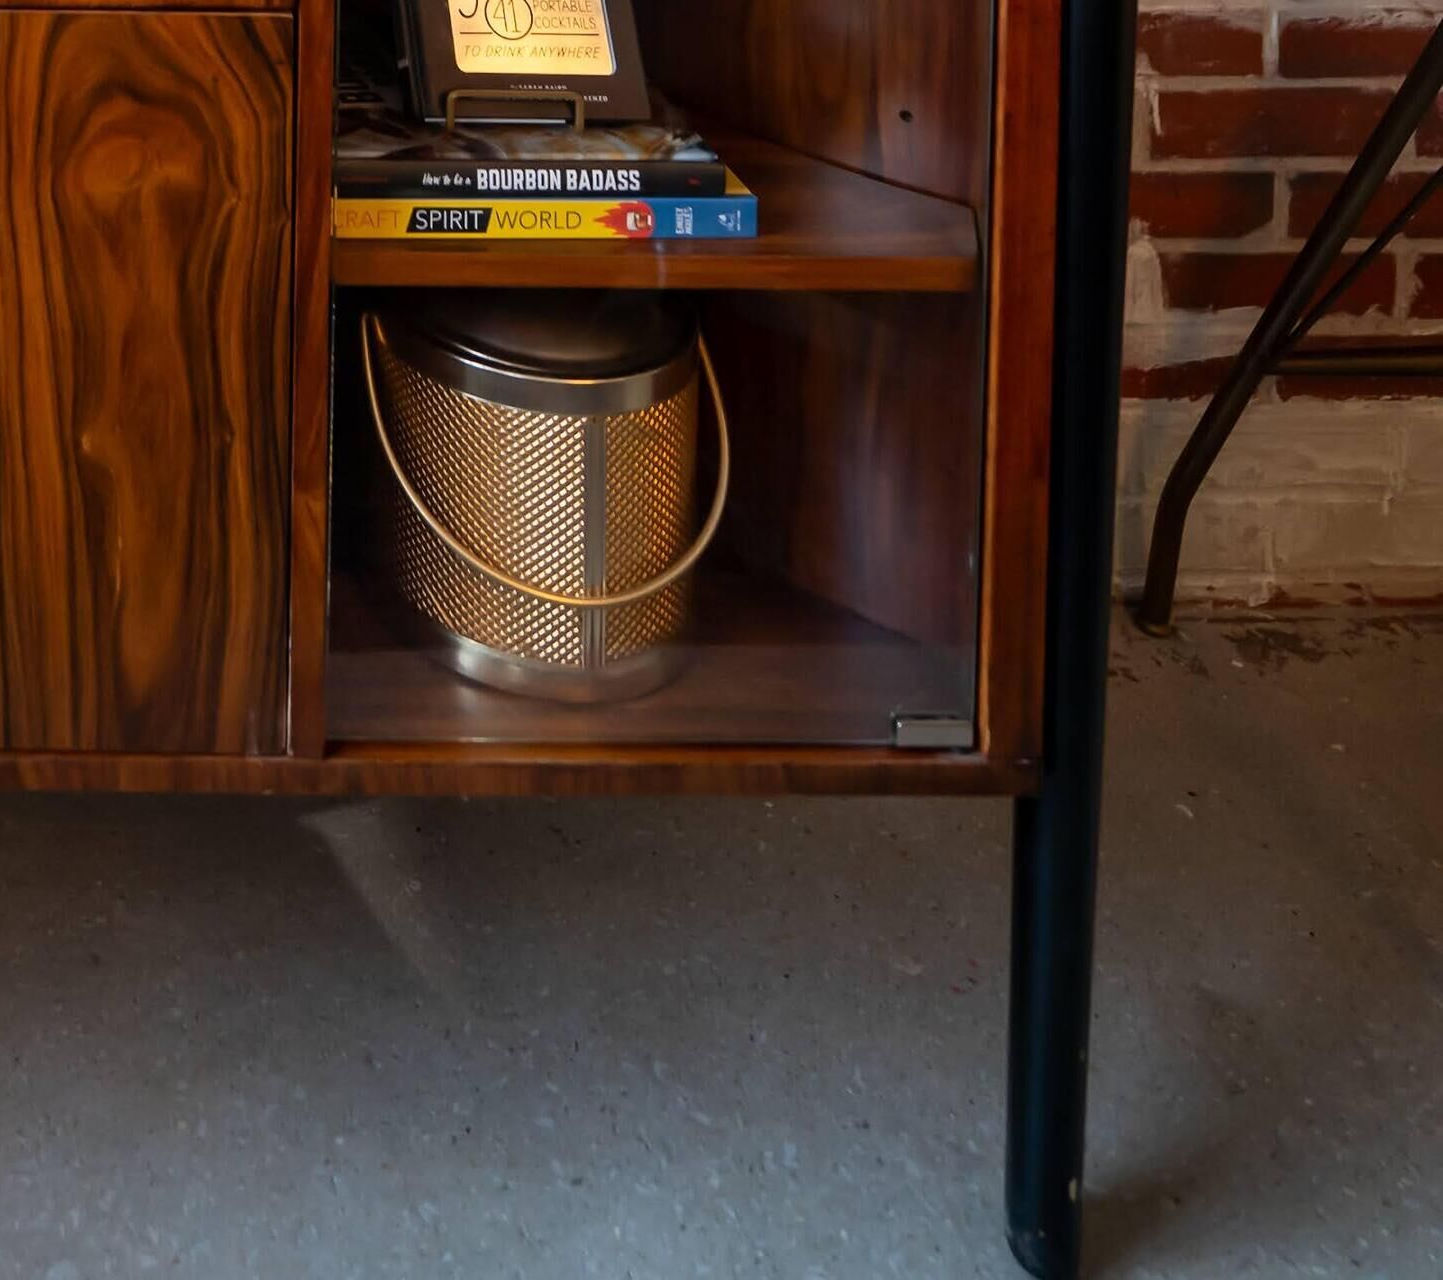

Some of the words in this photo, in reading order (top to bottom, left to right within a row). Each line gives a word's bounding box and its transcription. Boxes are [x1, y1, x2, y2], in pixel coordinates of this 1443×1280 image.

[533, 0, 593, 13] PORTABLE
[534, 17, 597, 30] COCKTAILS
[464, 45, 481, 58] TO
[486, 45, 524, 58] DRINK
[531, 46, 601, 59] ANYWHERE
[422, 172, 439, 186] How
[442, 173, 451, 185] to
[477, 168, 561, 190] BOURBON
[566, 168, 641, 191] BADASS
[415, 208, 484, 231] SPIRIT
[495, 209, 582, 231] WORLD
